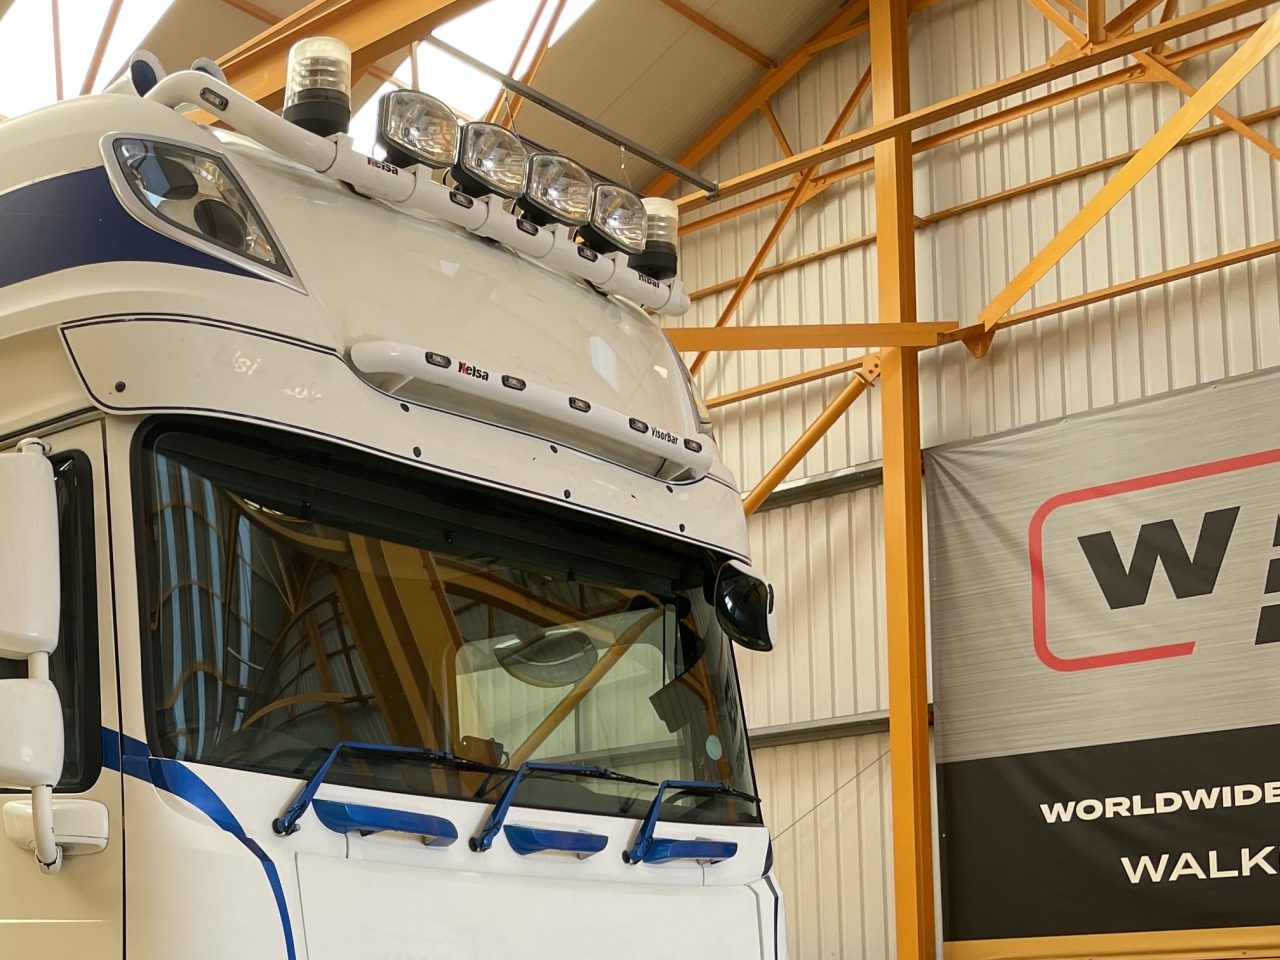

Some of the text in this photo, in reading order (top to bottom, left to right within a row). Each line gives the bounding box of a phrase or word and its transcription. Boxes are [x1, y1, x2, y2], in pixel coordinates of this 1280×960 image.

[457, 361, 489, 381] Kelsa
[650, 425, 679, 446] VisorBar
[1120, 845, 1280, 884] WALK
